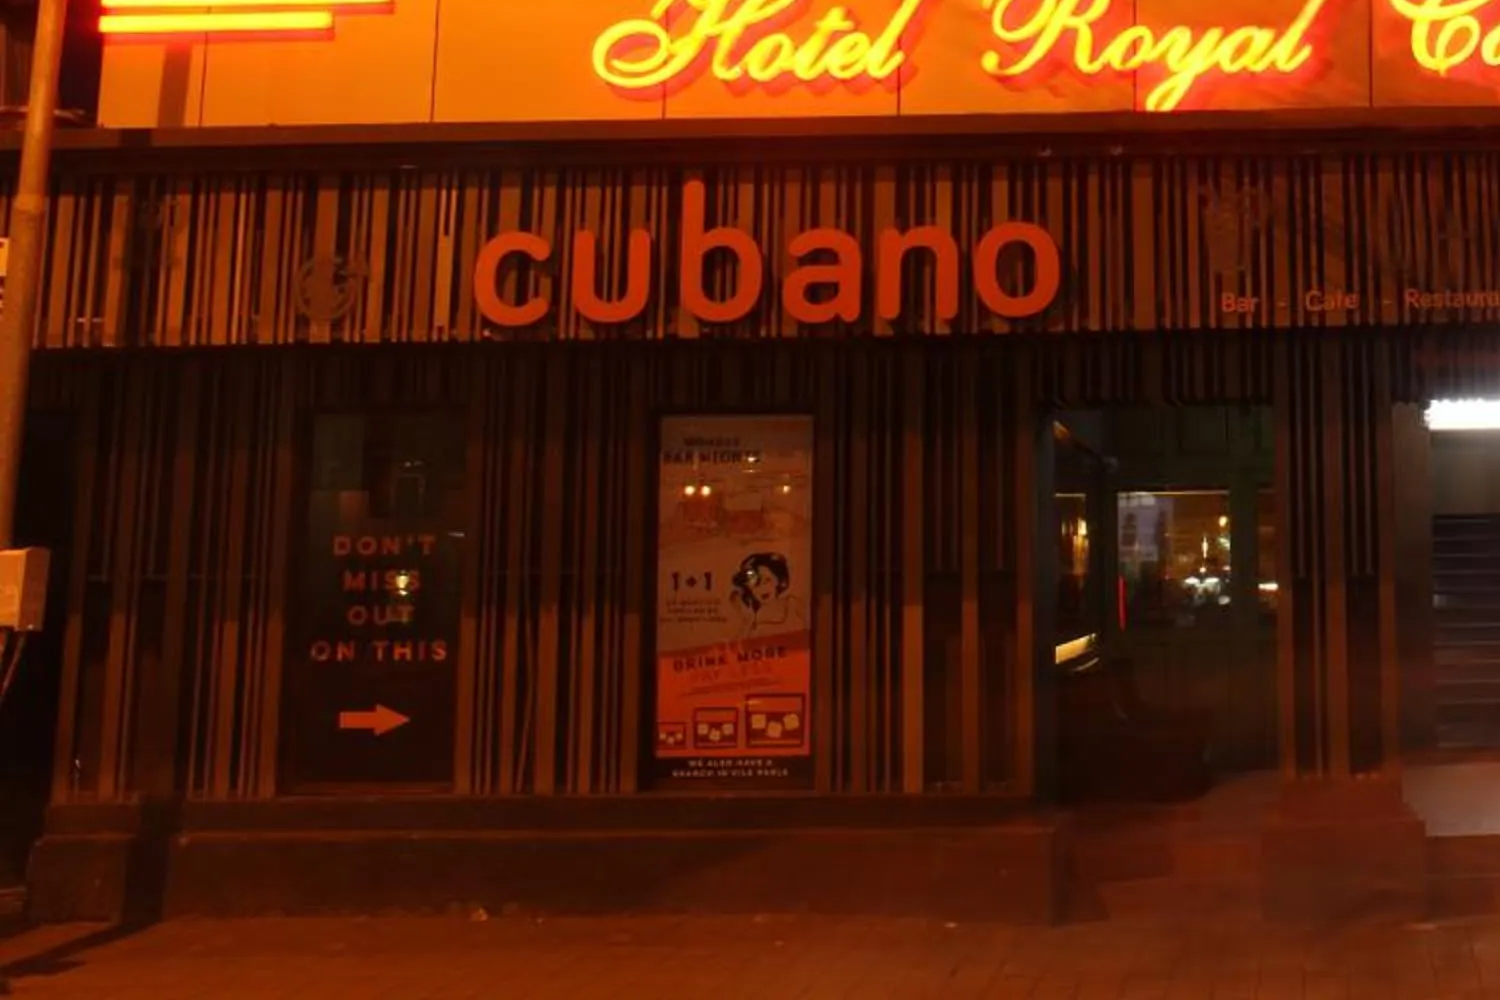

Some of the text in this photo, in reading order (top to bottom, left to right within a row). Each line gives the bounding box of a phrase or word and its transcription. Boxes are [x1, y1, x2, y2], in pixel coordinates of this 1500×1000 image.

[474, 179, 1061, 327] cubano
[1221, 292, 1260, 313] Bar
[1304, 289, 1360, 312] Cafe
[333, 535, 436, 556] DON'T
[342, 571, 421, 592] MISS
[346, 605, 414, 626] OUT
[310, 640, 448, 662] ON THIS
